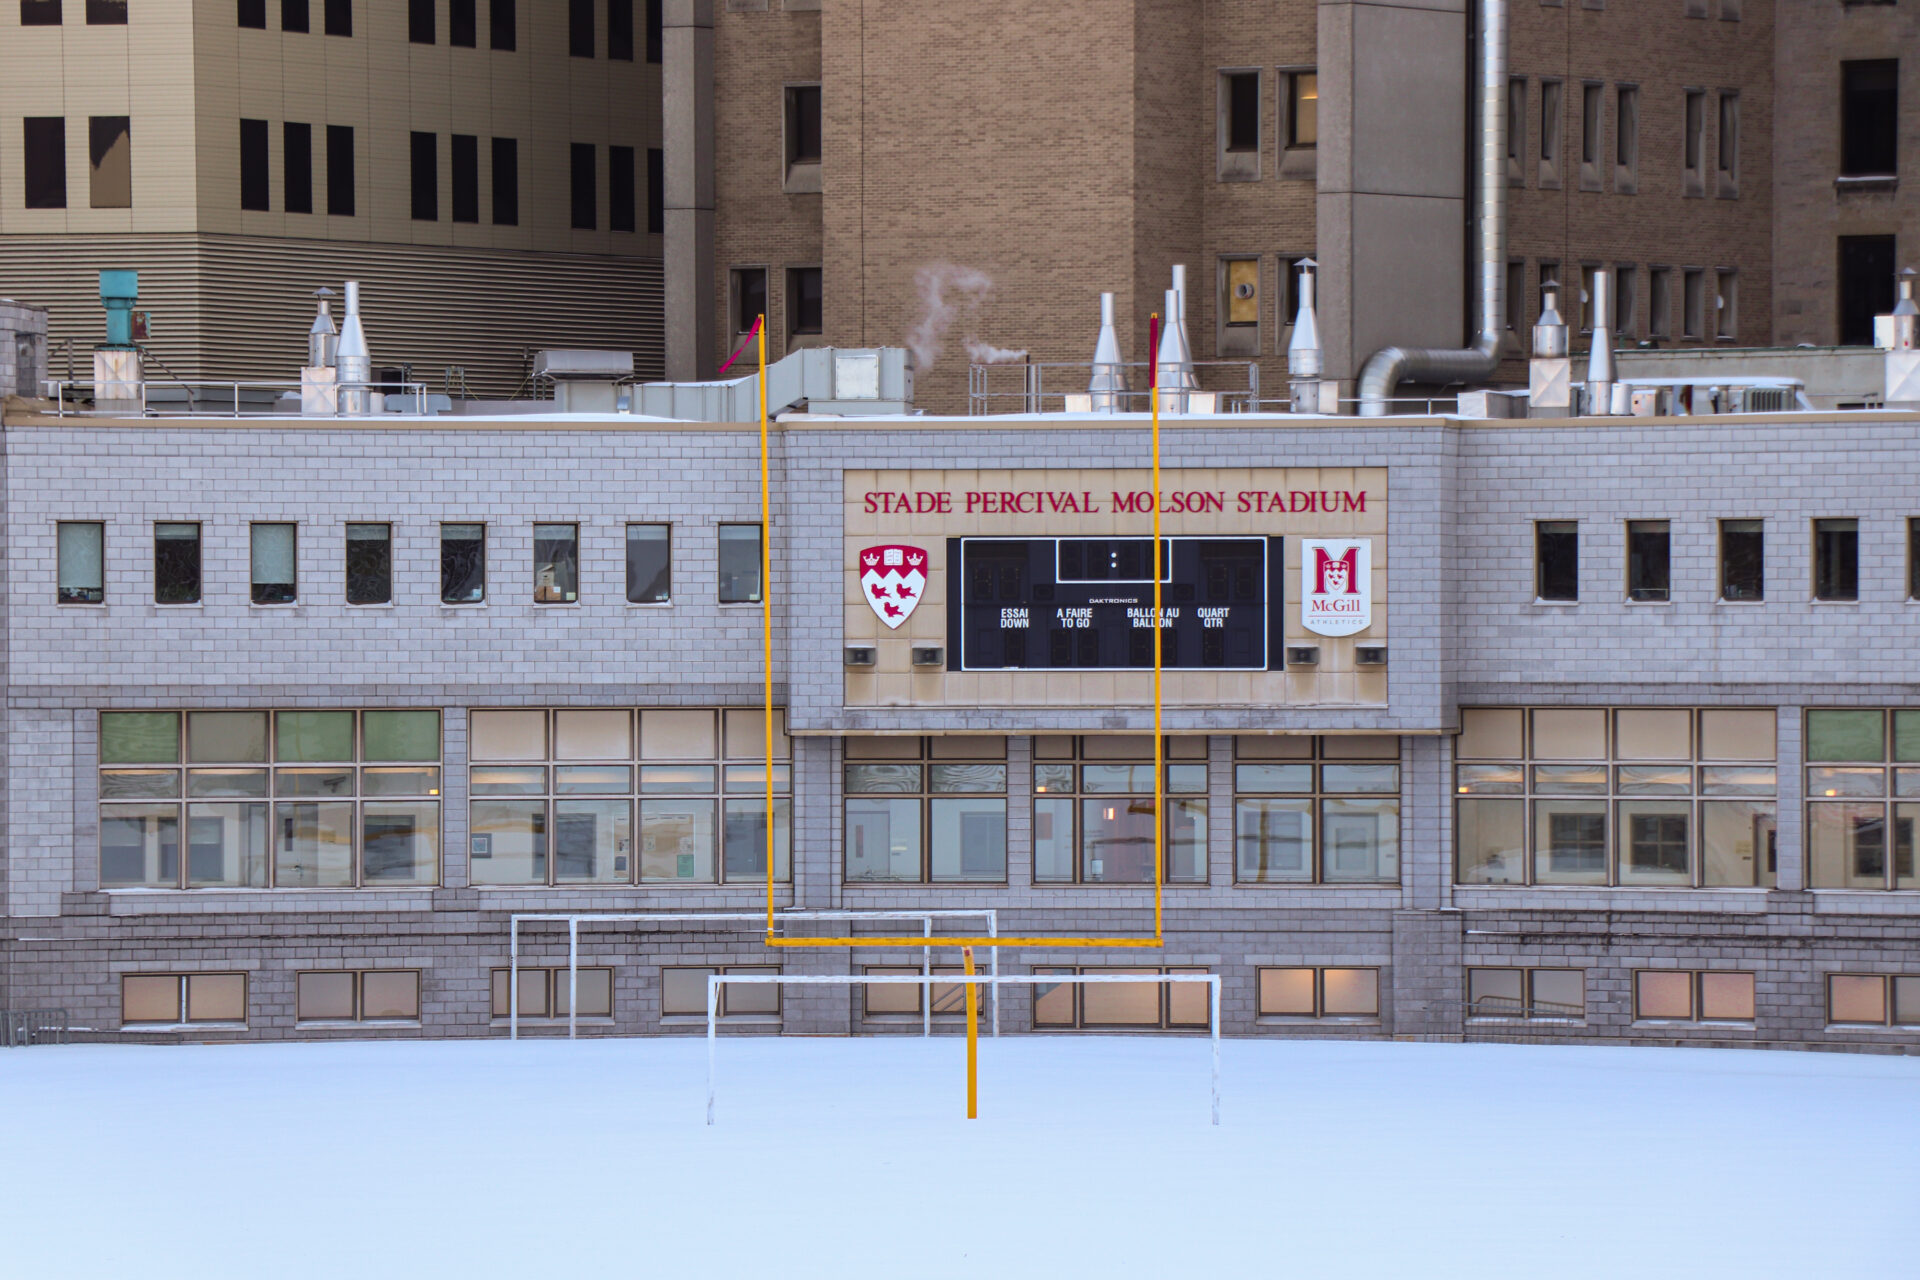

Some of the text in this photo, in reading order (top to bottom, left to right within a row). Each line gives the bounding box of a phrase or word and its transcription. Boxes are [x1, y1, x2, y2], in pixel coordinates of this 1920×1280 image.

[864, 490, 1367, 513] STADE PERCIVAL MOLSON STADIUM
[1311, 546, 1361, 595] M
[1311, 599, 1360, 612] McGill
[1001, 607, 1029, 618] ESSAI
[1056, 607, 1093, 618] A FAIRE
[1127, 607, 1180, 618] BALLON AU
[1197, 607, 1230, 618] QUART
[1001, 618, 1030, 628] DOWN
[1061, 618, 1090, 628] TO GO
[1203, 618, 1224, 628] QTR
